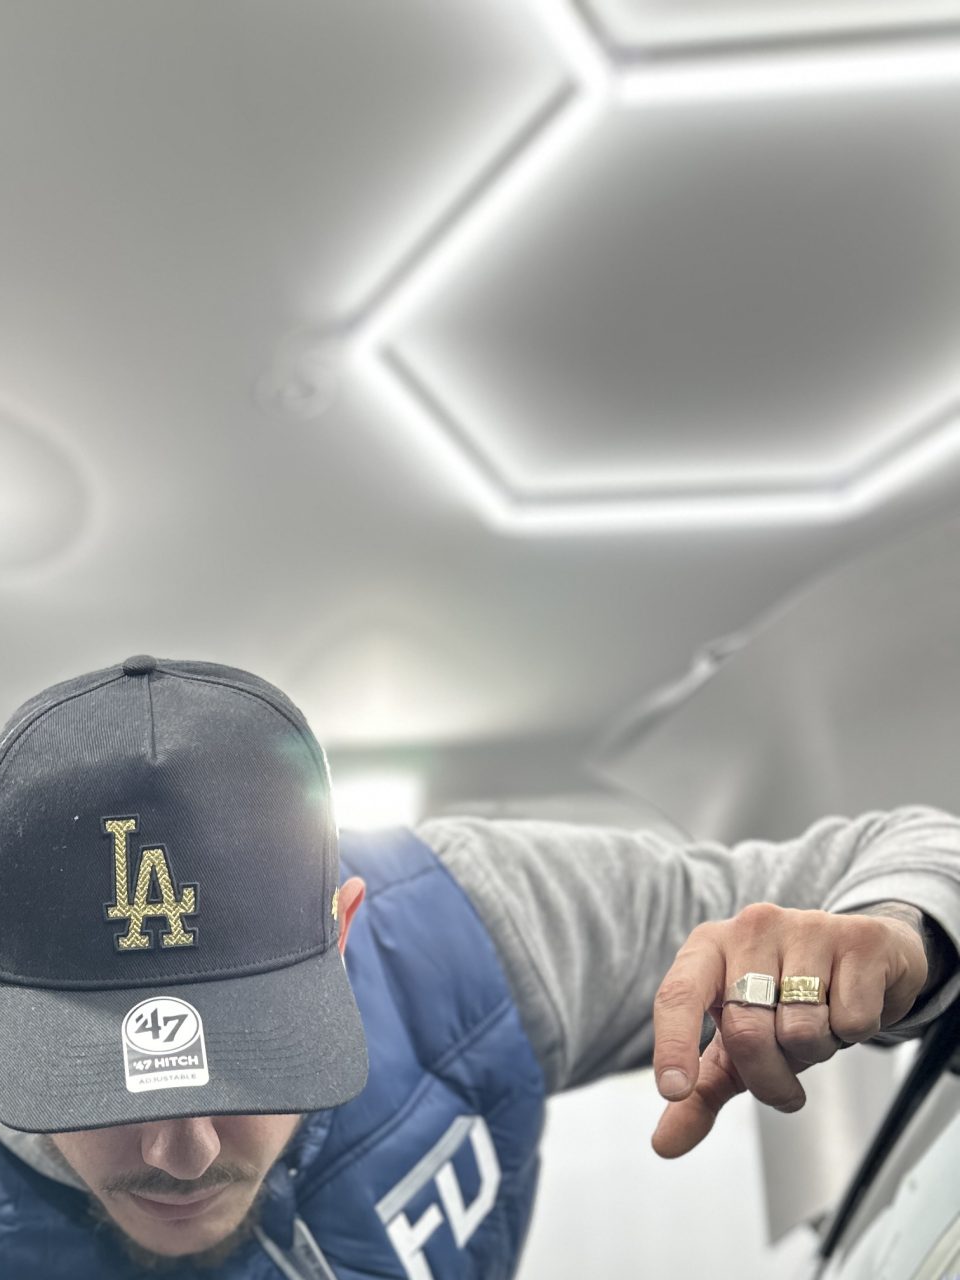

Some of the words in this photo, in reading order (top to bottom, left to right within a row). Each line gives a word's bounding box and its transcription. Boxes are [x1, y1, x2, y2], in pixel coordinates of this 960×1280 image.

[103, 818, 196, 948] LA
[154, 1055, 199, 1068] HITCH
[138, 1073, 197, 1085] ADJUSTABLE
